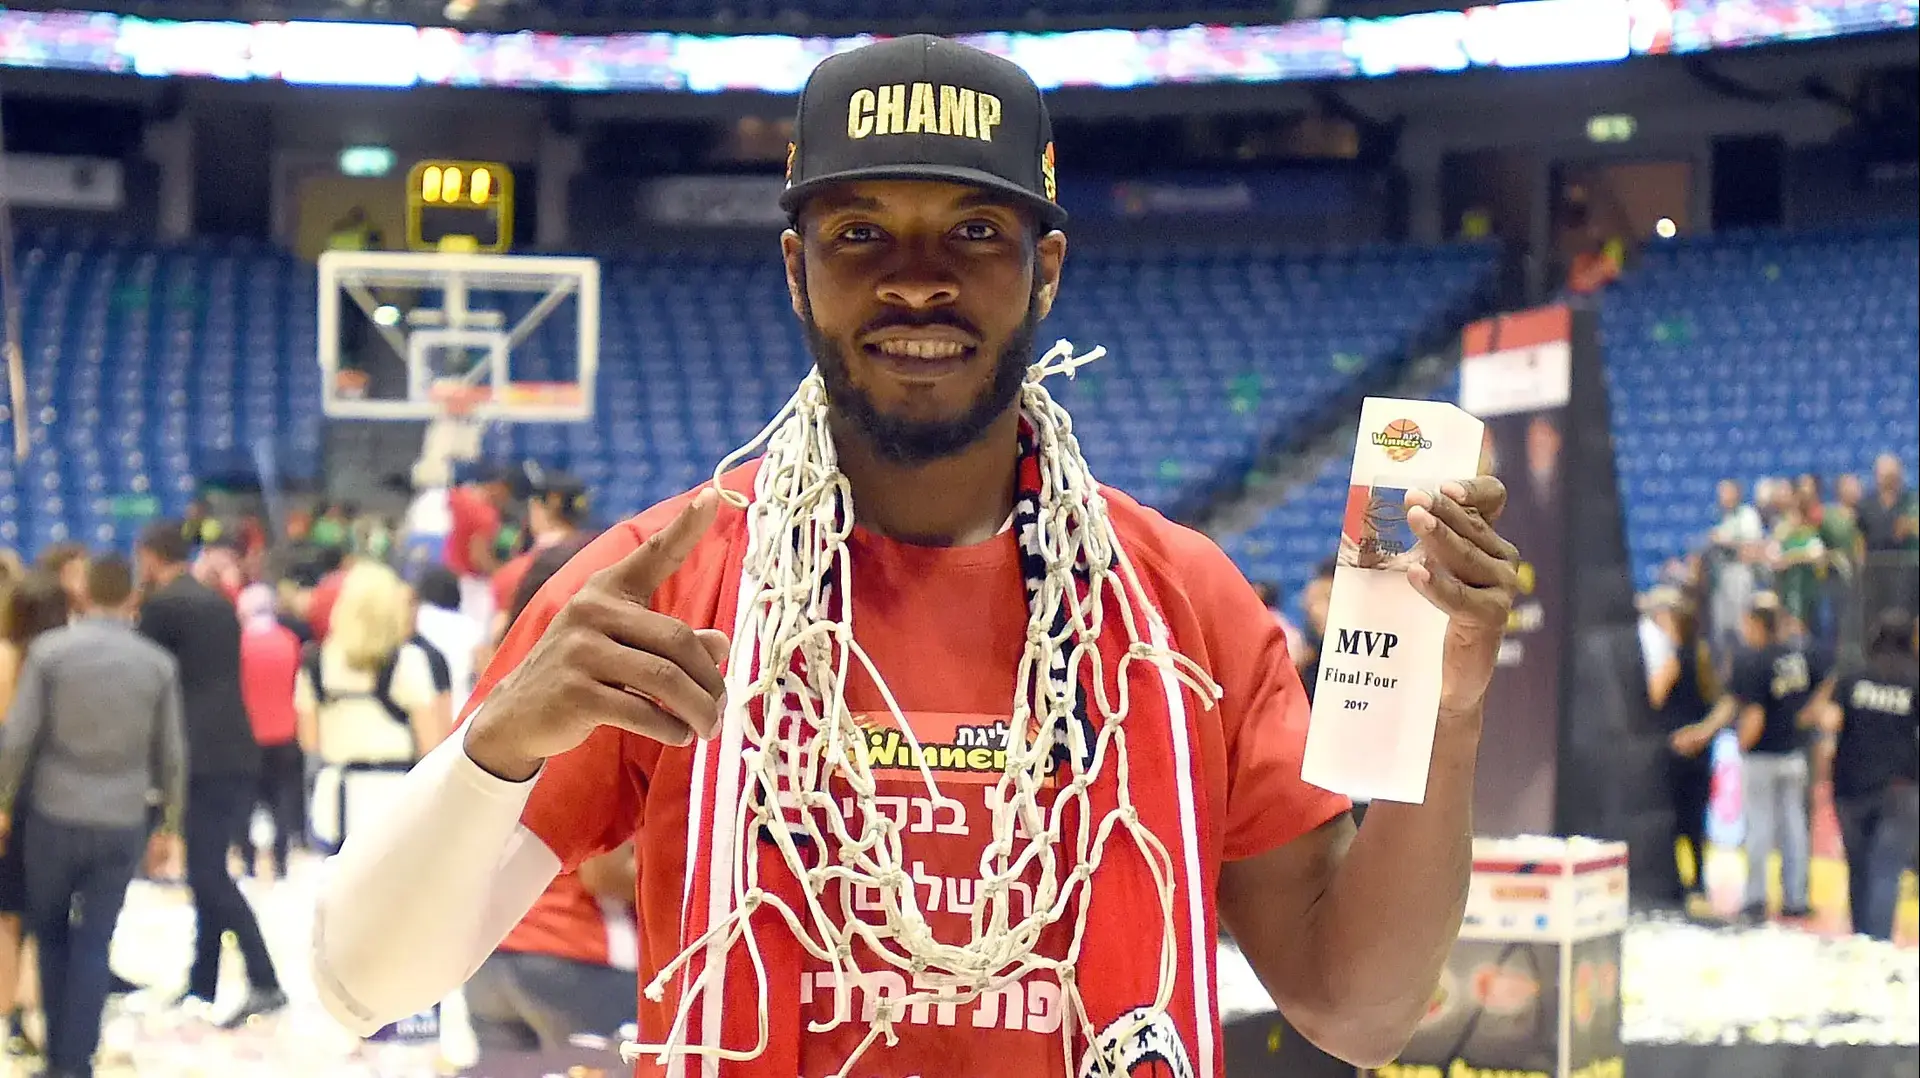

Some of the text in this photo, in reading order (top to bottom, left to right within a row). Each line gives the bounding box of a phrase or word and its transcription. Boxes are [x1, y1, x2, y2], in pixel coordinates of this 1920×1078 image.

[848, 82, 1001, 141] CHAMP
[1372, 432, 1420, 448] Winner
[1335, 628, 1398, 658] MVP
[1325, 667, 1398, 689] Final Four
[1344, 699, 1369, 711] 2017
[956, 721, 1010, 747] ליגת
